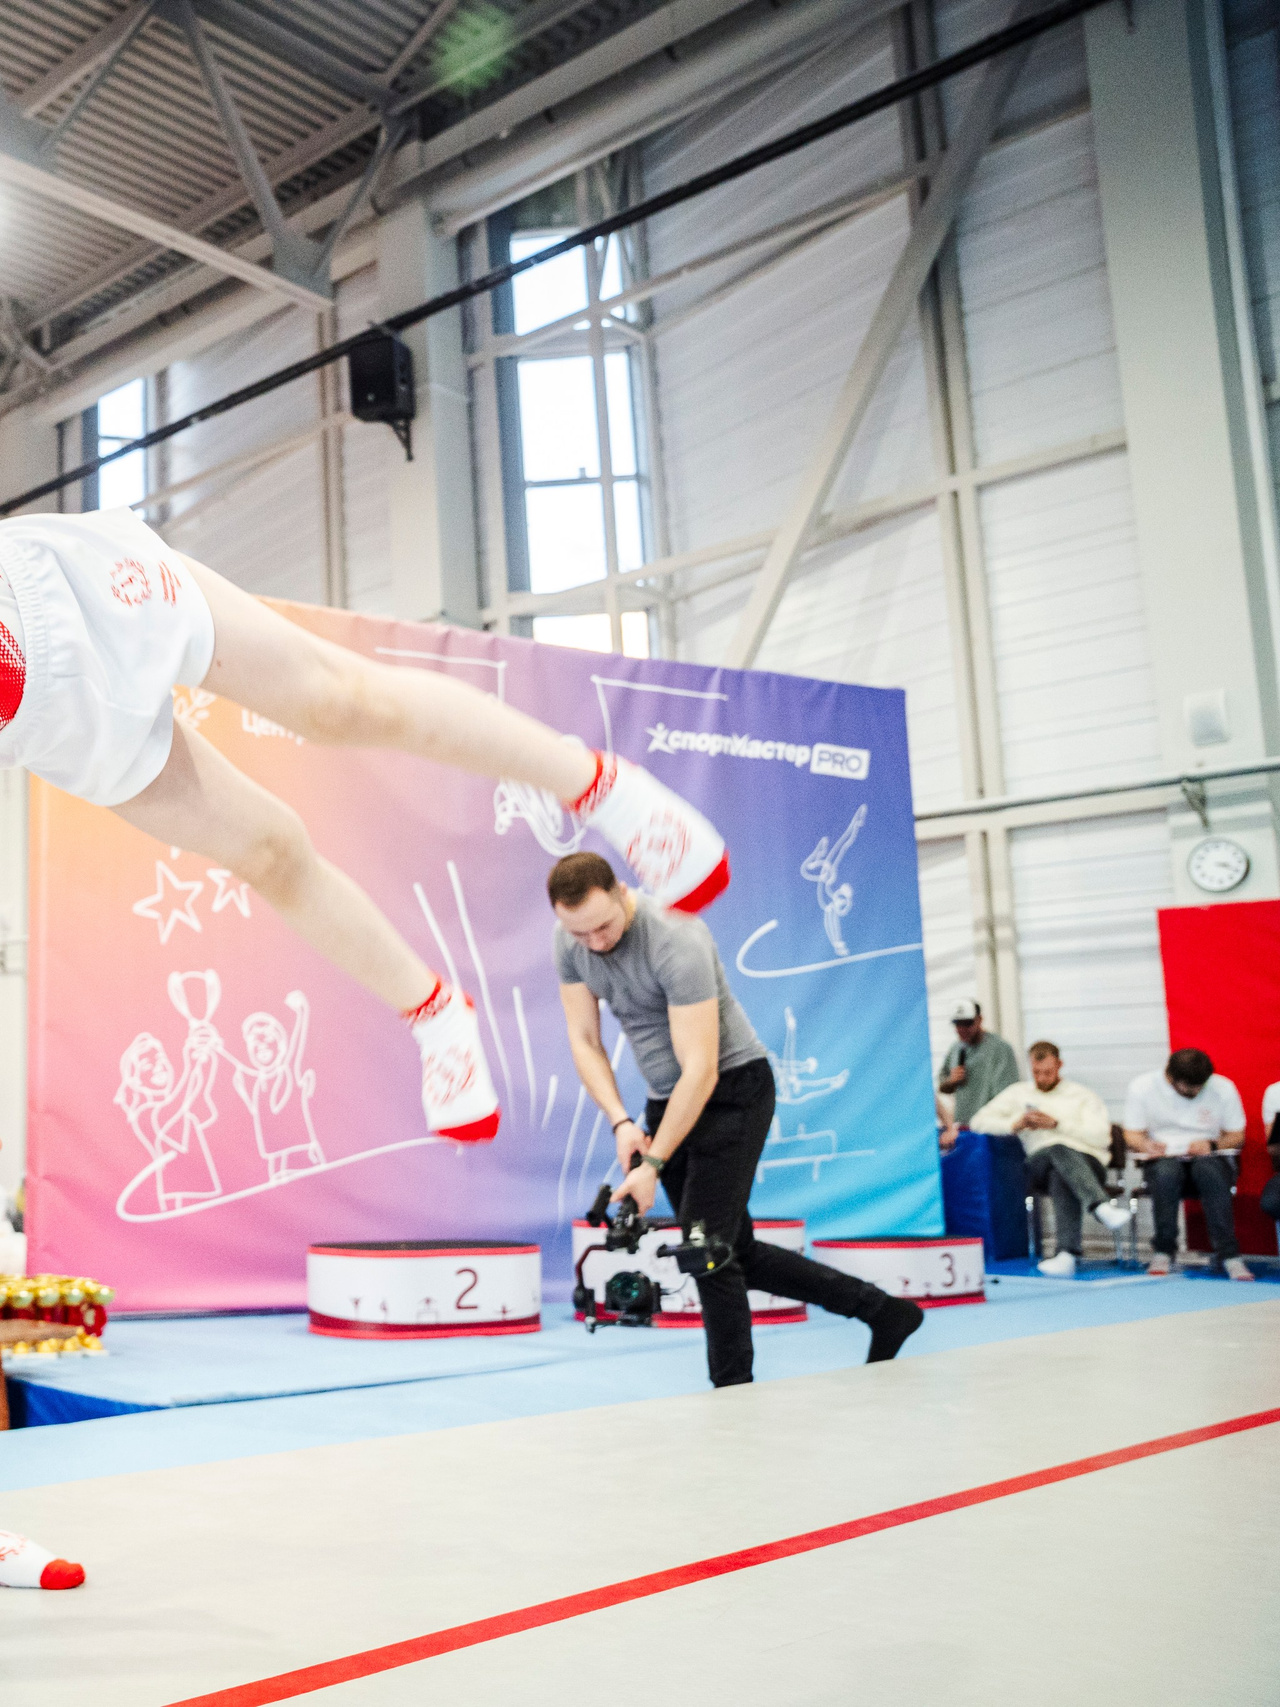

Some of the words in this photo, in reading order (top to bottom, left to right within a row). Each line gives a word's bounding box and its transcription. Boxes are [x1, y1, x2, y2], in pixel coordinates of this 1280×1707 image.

[241, 708, 304, 745] Цен
[818, 749, 863, 773] PRO
[940, 1252, 956, 1288] 3
[455, 1268, 478, 1310] 2
